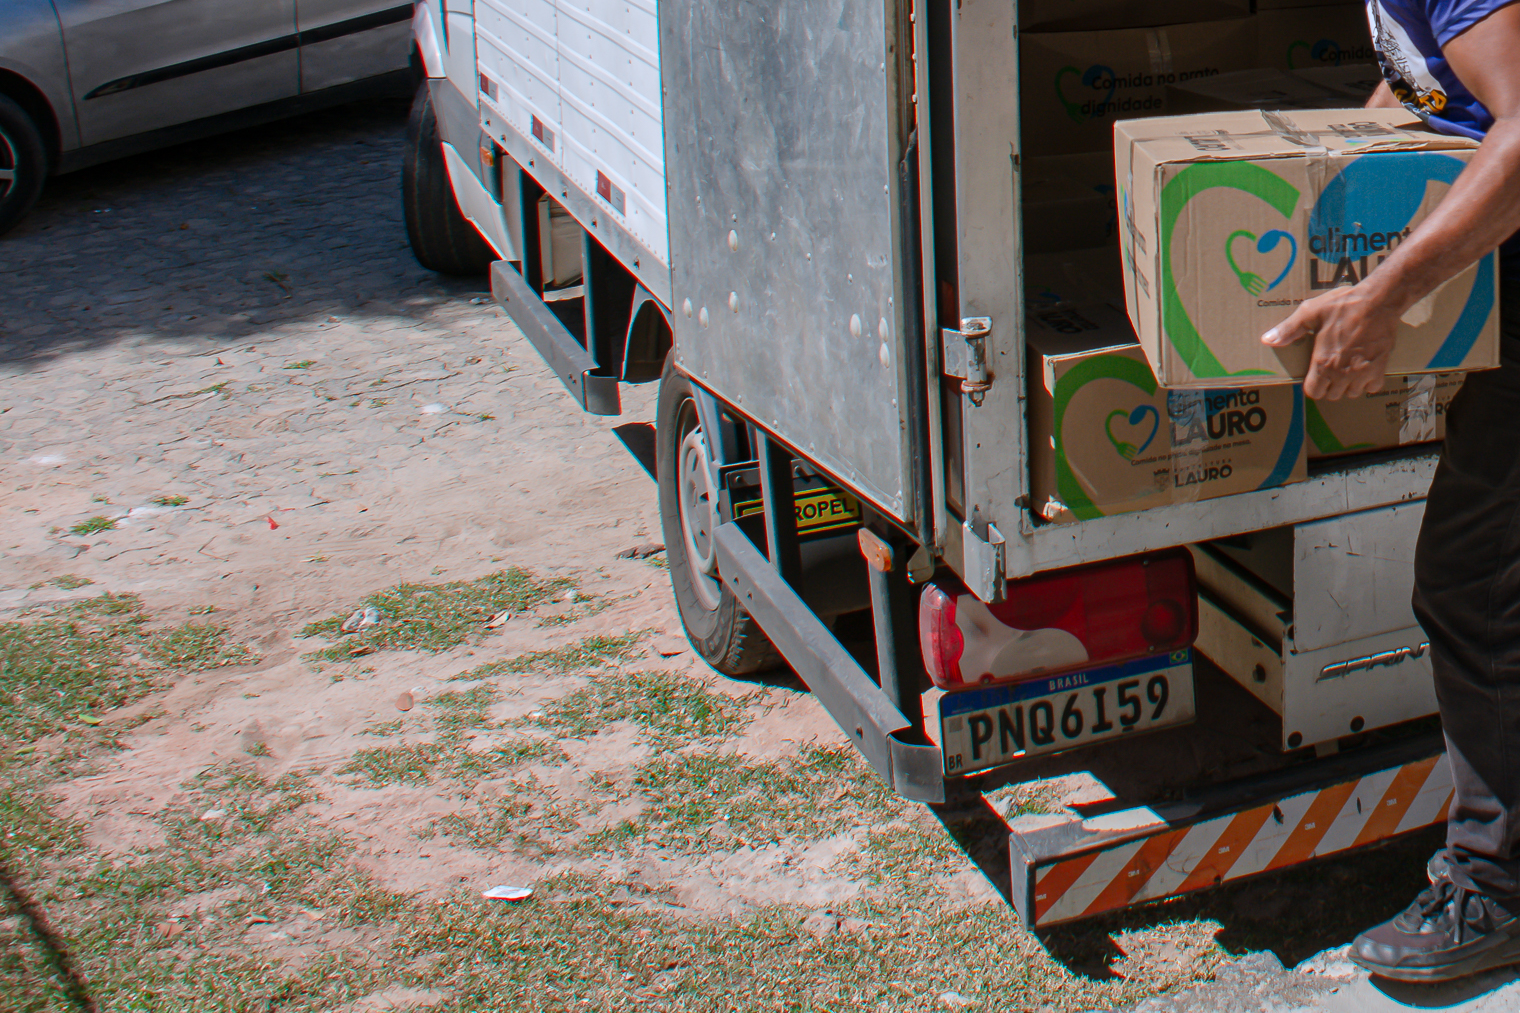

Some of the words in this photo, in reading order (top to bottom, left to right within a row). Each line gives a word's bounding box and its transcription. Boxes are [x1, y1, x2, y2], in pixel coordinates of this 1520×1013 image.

[1319, 46, 1373, 63] Comida
[1092, 72, 1153, 90] Comida
[1157, 72, 1175, 85] no
[1081, 96, 1162, 117] dignidade
[1257, 298, 1291, 308] Comida
[1171, 406, 1267, 447] LAURO
[1131, 457, 1158, 467] Comida
[1158, 453, 1168, 461] no
[1233, 439, 1252, 447] mesa.
[1175, 464, 1233, 488] LAURO
[1049, 673, 1089, 691] BRASIL
[968, 675, 1170, 761] PNQ6I59
[948, 753, 964, 770] BR
